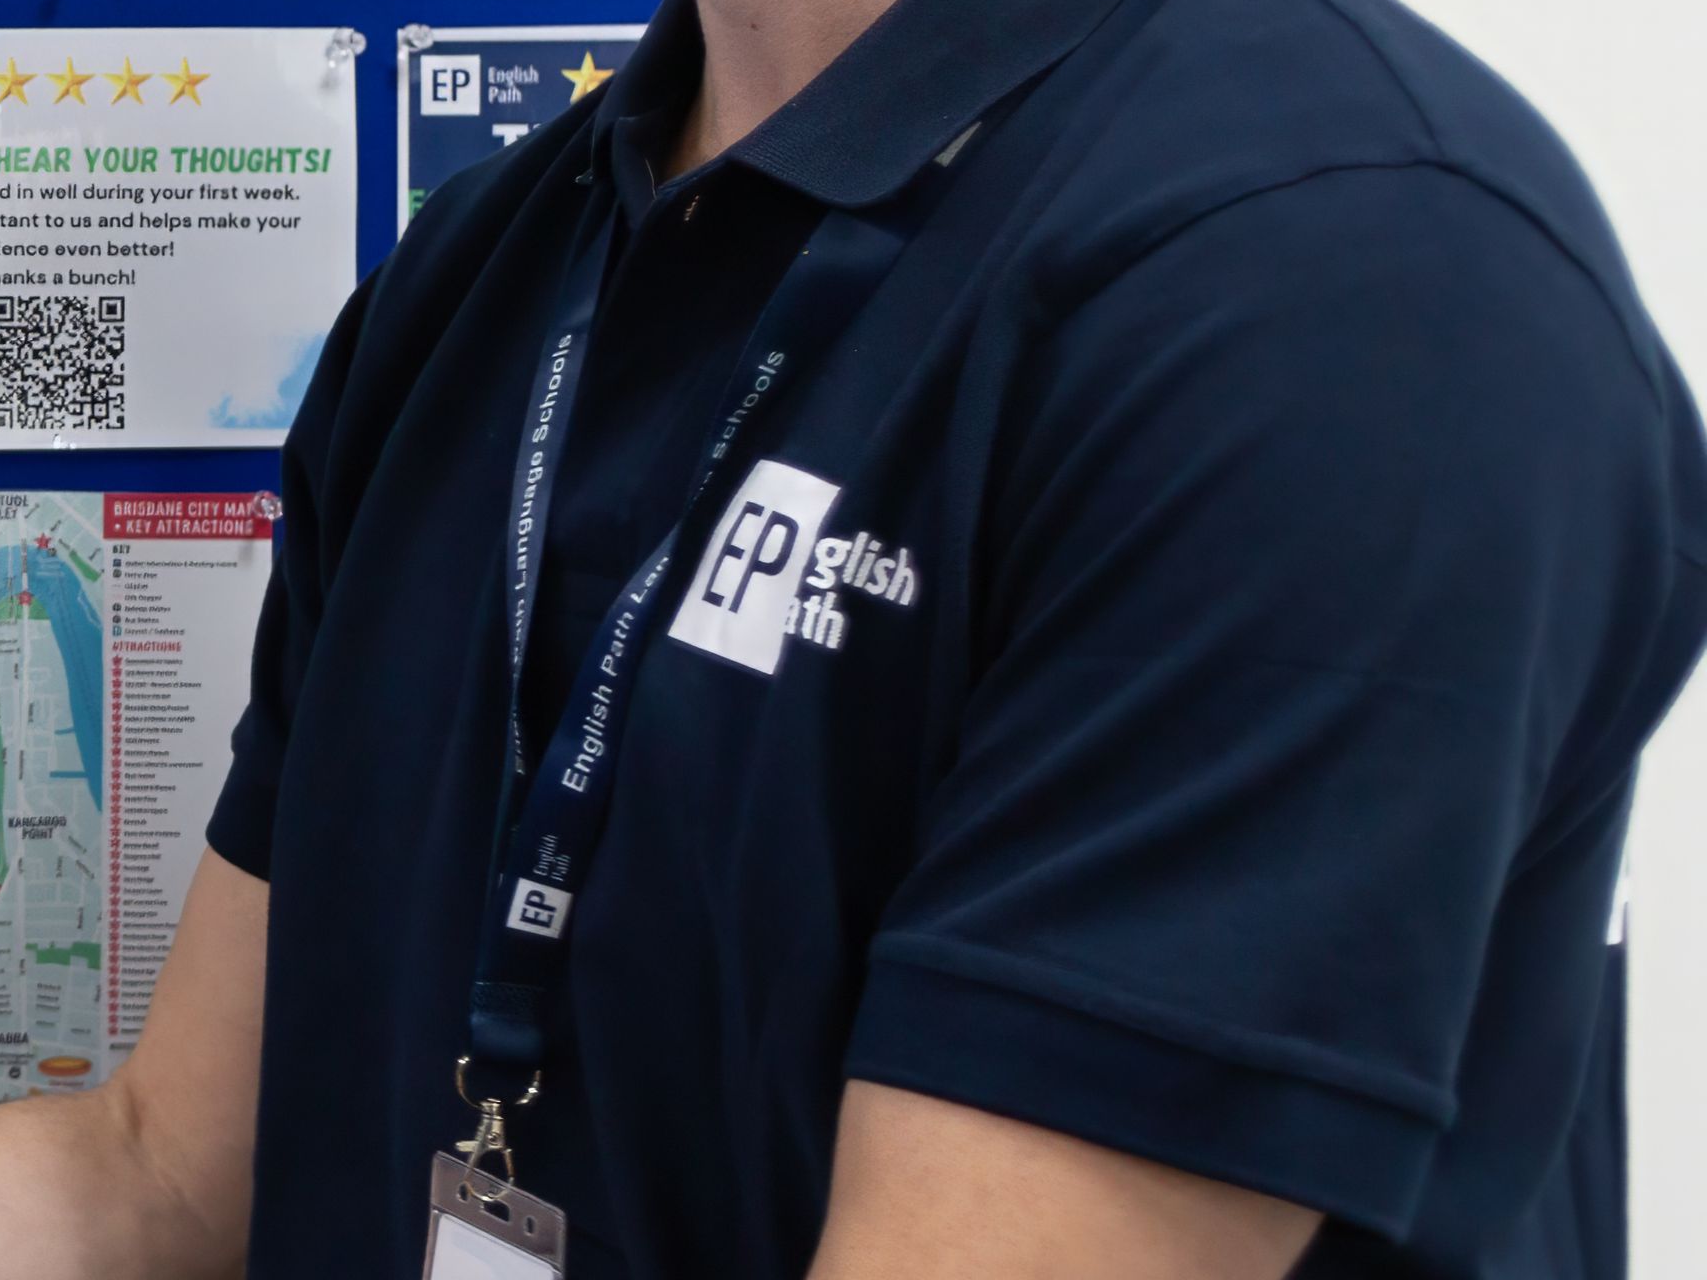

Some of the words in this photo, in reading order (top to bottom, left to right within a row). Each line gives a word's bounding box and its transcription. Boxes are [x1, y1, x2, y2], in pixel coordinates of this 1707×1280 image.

[432, 68, 471, 102] EP
[487, 64, 540, 85] English
[487, 86, 523, 104] Path
[84, 147, 158, 173] YOUR
[17, 183, 34, 199] in
[39, 183, 77, 200] well
[82, 183, 145, 205] during
[150, 188, 194, 204] your
[199, 183, 238, 200] first
[244, 184, 300, 201] week.
[44, 214, 65, 228] to
[70, 216, 92, 228] us
[97, 212, 134, 228] and
[139, 212, 192, 233] helps
[197, 212, 251, 229] make
[256, 216, 301, 233] your
[55, 244, 102, 257] even
[106, 240, 174, 257] better!
[52, 273, 64, 285] a
[68, 269, 136, 286] bunch!
[514, 450, 544, 591] Language
[531, 333, 573, 444] Schools
[113, 500, 183, 517] BRISBANE
[187, 501, 220, 517] CITY
[125, 519, 152, 535] KEY
[155, 519, 254, 536] ATTRACTIONS
[701, 499, 797, 616] EP
[560, 683, 614, 794] English
[599, 611, 636, 678] Path
[519, 888, 558, 930] EP
